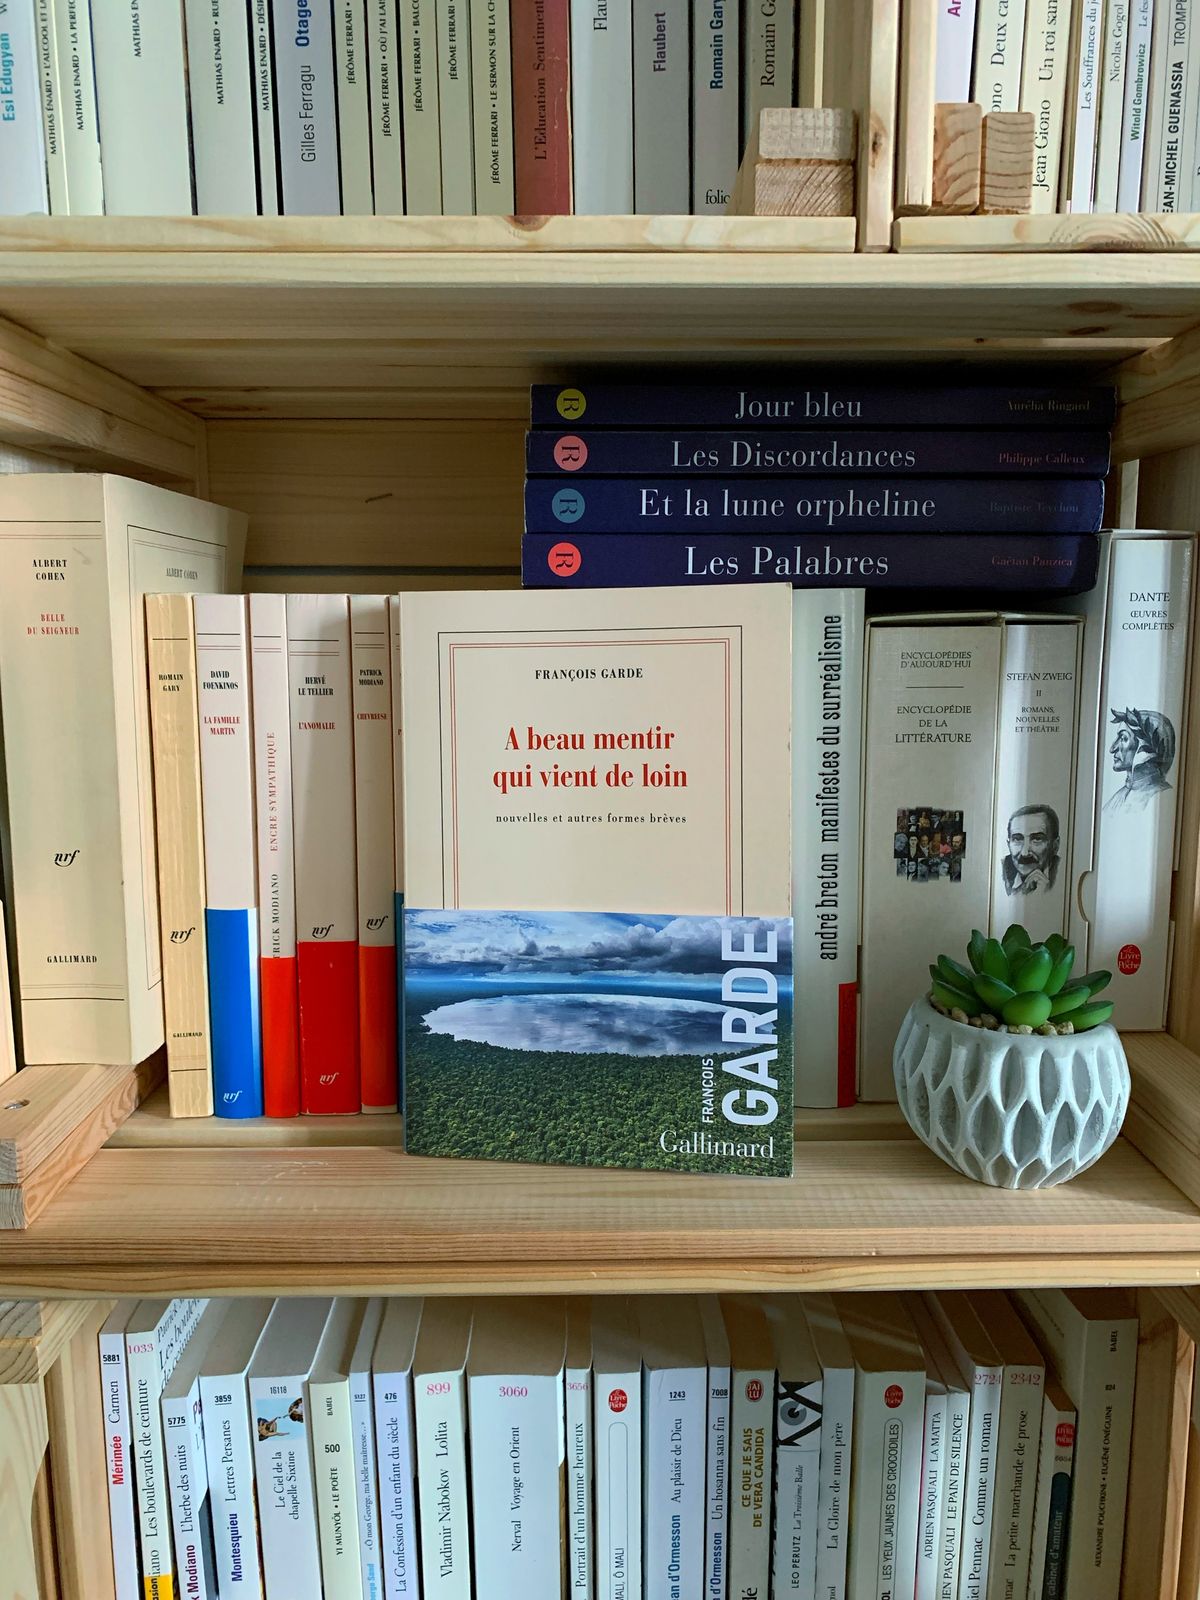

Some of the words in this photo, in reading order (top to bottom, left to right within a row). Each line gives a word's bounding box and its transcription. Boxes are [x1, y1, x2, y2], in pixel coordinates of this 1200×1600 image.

[487, 14, 496, 26] LA
[1086, 7, 1097, 22] du
[1112, 4, 1126, 38] Gogol
[488, 28, 497, 47] SUR
[652, 12, 666, 73] Flaubert
[1041, 31, 1055, 52] roi
[0, 33, 14, 95] Edugyan
[488, 49, 498, 89] SERMON
[709, 34, 724, 90] Romain
[1038, 58, 1054, 81] Un
[1082, 25, 1097, 89] Souffrances
[1109, 41, 1122, 82] Nicolas
[1131, 43, 1146, 105] Gombrowicz
[44, 80, 54, 112] ÉNARD
[298, 65, 315, 119] Ferragu
[489, 90, 498, 100] LE
[1080, 91, 1092, 110] Les
[1167, 61, 1184, 134] GUENASSIA
[2, 99, 16, 121] Esi
[533, 77, 548, 161] L'Education
[46, 114, 57, 155] MATHIAS
[489, 111, 499, 147] FERRARI
[1034, 99, 1051, 149] Giono
[1129, 108, 1141, 141] Witold
[300, 124, 316, 163] Gilles
[490, 149, 501, 184] JÉRÔME
[1032, 155, 1050, 192] Jean
[735, 391, 794, 420] Jour
[803, 391, 863, 417] bleu
[671, 440, 719, 467] Les
[729, 440, 916, 468] Discordances
[639, 488, 673, 517] Et
[683, 488, 711, 517] la
[721, 488, 785, 517] lune
[796, 488, 936, 526] orpheline
[32, 559, 68, 568] ALBERT
[684, 545, 739, 576] Les
[751, 545, 889, 576] Palabres
[35, 572, 66, 581] COHEN
[1129, 592, 1171, 602] DANTE
[40, 613, 65, 622] BELLE
[1122, 621, 1175, 631] COMPLÈTES
[1130, 610, 1168, 618] ŒUVRES
[27, 626, 37, 635] DU
[41, 626, 80, 635] SEIGNEUR
[900, 651, 972, 659] ENCYCLOPÉDIES
[900, 660, 971, 668] D'AUJOURD'HUI
[210, 670, 230, 679] DAVID
[304, 675, 326, 685] HERVÉ
[535, 668, 597, 681] FRANÇOIS
[601, 667, 643, 679] GARDE
[818, 615, 842, 721] surréalisme
[1006, 672, 1041, 681] STEFAN
[1042, 672, 1073, 681] ZWEIG
[202, 681, 239, 690] FOENKINOS
[298, 687, 308, 696] LE
[308, 687, 334, 696] TELLIER
[204, 716, 213, 724] LA
[213, 716, 240, 725] FAMILLE
[896, 704, 972, 714] ENCYCLOPÉDIE
[210, 727, 236, 735] MARTIN
[298, 721, 336, 730] L'ANOMALIE
[817, 726, 840, 746] du
[919, 719, 932, 728] DE
[933, 719, 948, 728] LA
[1026, 724, 1060, 733] THÉÂTRE
[504, 726, 520, 750] A
[527, 726, 585, 750] beau
[592, 725, 675, 750] mentir
[895, 732, 972, 743] LITTÉRATURE
[267, 732, 276, 812] SYMPATHIQUE
[492, 764, 533, 794] qui
[539, 764, 598, 788] vient
[605, 763, 634, 788] de
[641, 762, 688, 788] loin
[817, 752, 840, 843] manifestes
[495, 812, 548, 823] nouvelles
[552, 814, 562, 823] et
[567, 814, 602, 823] autres
[606, 812, 645, 823] formes
[649, 812, 687, 824] brèves
[268, 816, 277, 852] ENCRE
[54, 849, 80, 867] nrf
[816, 853, 839, 909] breton
[271, 873, 280, 924] MODIANO
[170, 926, 195, 944] nrf
[816, 914, 838, 961] andré
[46, 954, 97, 963] GALLIMARD
[721, 928, 778, 1126] GARDE
[701, 1058, 717, 1124] FRANÇOIS
[660, 1130, 773, 1159] Gallimard
[102, 1354, 120, 1363] 5881
[127, 1343, 154, 1354] 1033
[214, 1394, 232, 1403] 3859
[384, 1392, 398, 1400] 476
[426, 1381, 451, 1395] 899
[498, 1386, 528, 1397] 3060
[668, 1391, 686, 1399] 1243
[108, 1380, 121, 1424] Carmen
[136, 1379, 150, 1428] ceinture
[139, 1432, 152, 1447] de
[220, 1420, 233, 1464] Persanes
[386, 1417, 399, 1444] siècle
[434, 1421, 449, 1457] Lolita
[671, 1418, 682, 1442] Dieu
[743, 1428, 753, 1453] SAIS
[830, 1422, 845, 1447] père
[981, 1413, 993, 1453] roman
[324, 1443, 340, 1453] 500
[387, 1446, 400, 1460] du
[509, 1427, 520, 1459] Orient
[670, 1444, 682, 1456] de
[753, 1427, 764, 1479] CANDIDA
[886, 1424, 900, 1481] CROCODILES
[112, 1436, 125, 1486] Mérimée
[511, 1462, 521, 1474] en
[670, 1458, 684, 1487] plaisir
[742, 1455, 753, 1467] JE
[831, 1451, 842, 1476] mon
[979, 1457, 989, 1474] un
[140, 1449, 157, 1514] boulevards
[223, 1466, 237, 1501] Lettres
[388, 1463, 402, 1495] enfant
[742, 1469, 753, 1491] QUE
[829, 1480, 841, 1493] de
[437, 1469, 452, 1523] Nabokov
[510, 1476, 523, 1511] Voyage
[671, 1489, 682, 1503] Au
[741, 1494, 752, 1508] CE
[753, 1481, 763, 1511] VERA
[885, 1483, 896, 1501] DES
[972, 1477, 987, 1526] Comme
[389, 1498, 402, 1520] d'un
[752, 1514, 762, 1528] DE
[827, 1496, 840, 1531] Gloire
[884, 1504, 895, 1537] JAUNES
[145, 1517, 159, 1538] Les
[510, 1520, 522, 1552] Nerval
[228, 1513, 243, 1582] Montesquieu
[391, 1522, 406, 1578] Confession
[439, 1526, 454, 1578] Vladimir
[668, 1514, 681, 1582] d'Ormesson
[826, 1535, 839, 1550] La
[882, 1539, 894, 1562] YEUX
[969, 1537, 984, 1581] Pennac
[882, 1565, 892, 1581] LES
[395, 1580, 407, 1592] La
